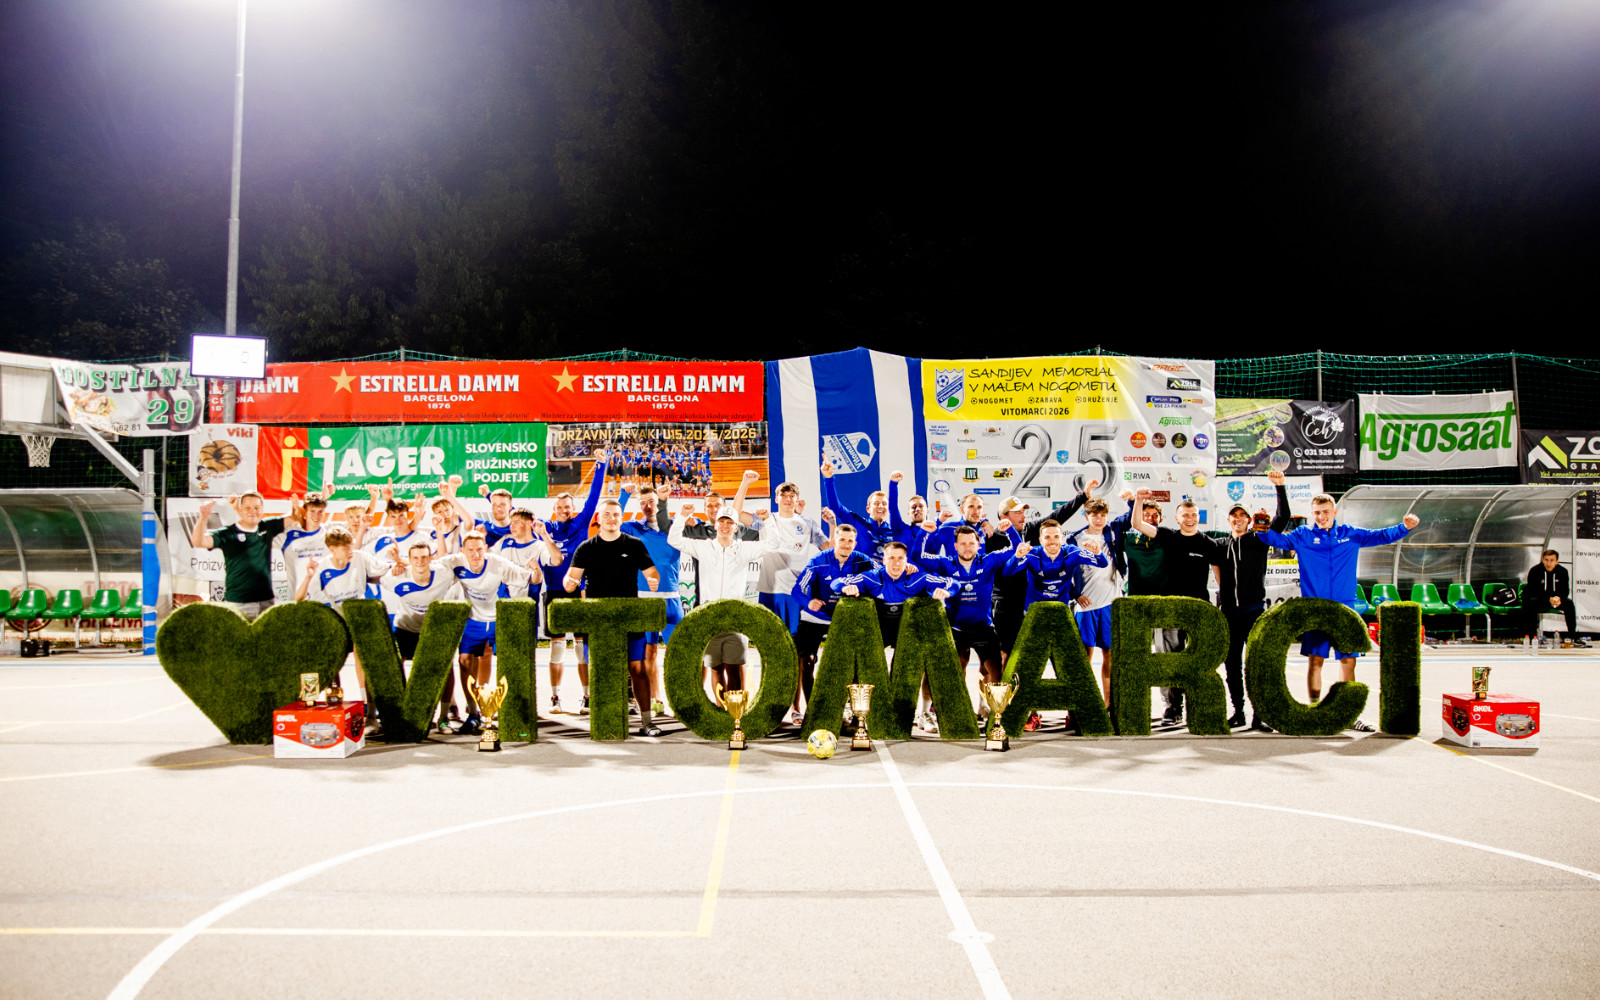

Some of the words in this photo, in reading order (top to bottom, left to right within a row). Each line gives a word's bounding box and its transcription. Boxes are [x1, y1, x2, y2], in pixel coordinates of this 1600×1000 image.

[58, 364, 197, 391] GOSTILNA
[968, 367, 1032, 381] SANDIJEV
[1042, 366, 1117, 378] MEMORIAL
[240, 376, 299, 393] DAMM
[360, 375, 452, 392] ESTRELLA
[458, 375, 519, 392] DAMM
[582, 375, 677, 392] ESTRELLA
[683, 375, 745, 392] DAMM
[969, 383, 979, 393] V
[983, 382, 1034, 392] MALEM
[1039, 381, 1118, 393] NOGOMETU
[403, 394, 474, 402] BARCELONA
[627, 394, 699, 402] BARCELONA
[147, 398, 195, 425] 29
[1000, 407, 1047, 416] VITOMARCI
[1048, 407, 1070, 415] 2026
[227, 427, 254, 438] Viki
[558, 428, 612, 441] DRŽAVNI
[614, 428, 660, 440] PRVAKI
[686, 428, 757, 440] 2025/2026
[1359, 401, 1516, 461] Agrosaat
[465, 442, 538, 454] SLOVENSKO
[838, 435, 863, 469] Vitomarci
[1304, 448, 1318, 456] 031
[1319, 448, 1333, 456] 529
[465, 458, 538, 470] DRUŽINSKO
[473, 472, 529, 483] PODJETJE
[191, 557, 225, 571] Proizv
[343, 596, 1421, 742] VITOMARCI
